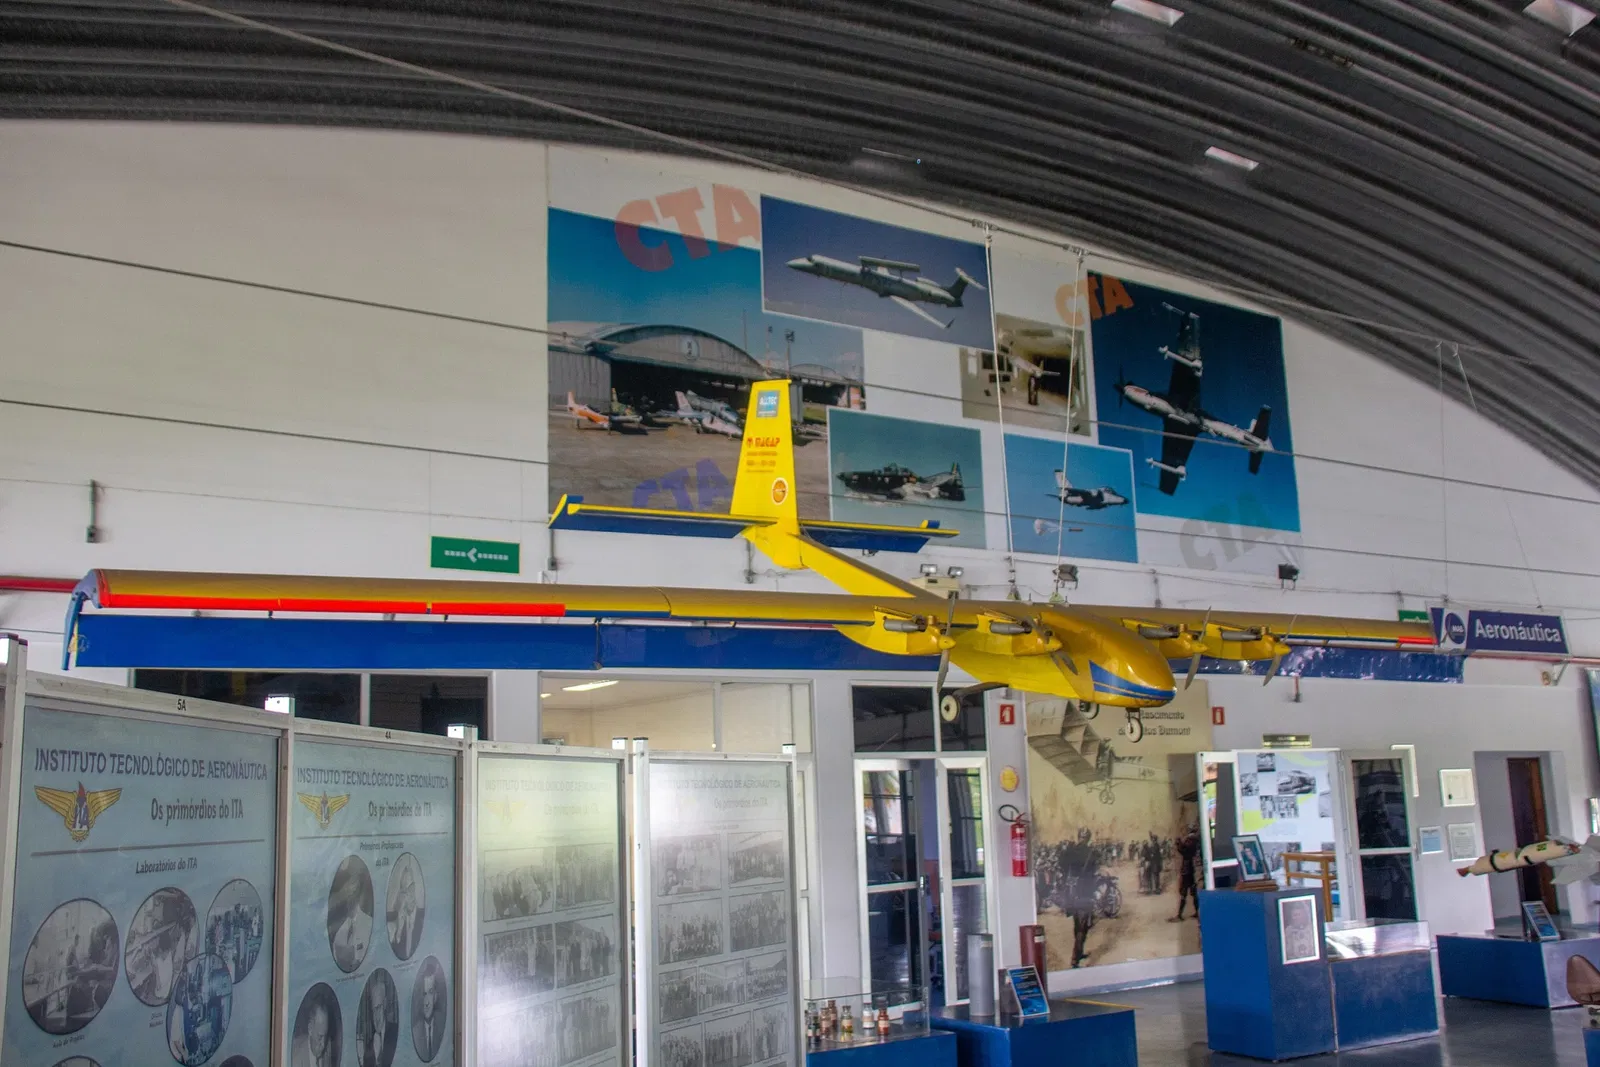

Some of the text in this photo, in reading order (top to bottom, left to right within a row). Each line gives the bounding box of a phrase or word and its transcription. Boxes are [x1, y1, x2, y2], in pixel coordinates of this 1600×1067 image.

[614, 183, 761, 273] CTA
[1055, 274, 1135, 327] CTA
[632, 457, 731, 511] CTA
[1179, 491, 1276, 571] CTA
[1475, 618, 1562, 643] Aeronáutica
[177, 699, 187, 711] 5A
[34, 748, 268, 781] INSTITUTO TECNOLÓGICO DE AERONÁUTICA
[297, 767, 449, 789] INSTITUTO TECNOLÓGICO DE AERONÁUTICA
[151, 797, 244, 826] Os primórdios do ITA
[368, 800, 432, 821] Os primórdios do ITA
[136, 857, 198, 874] Laboratórios do ITA
